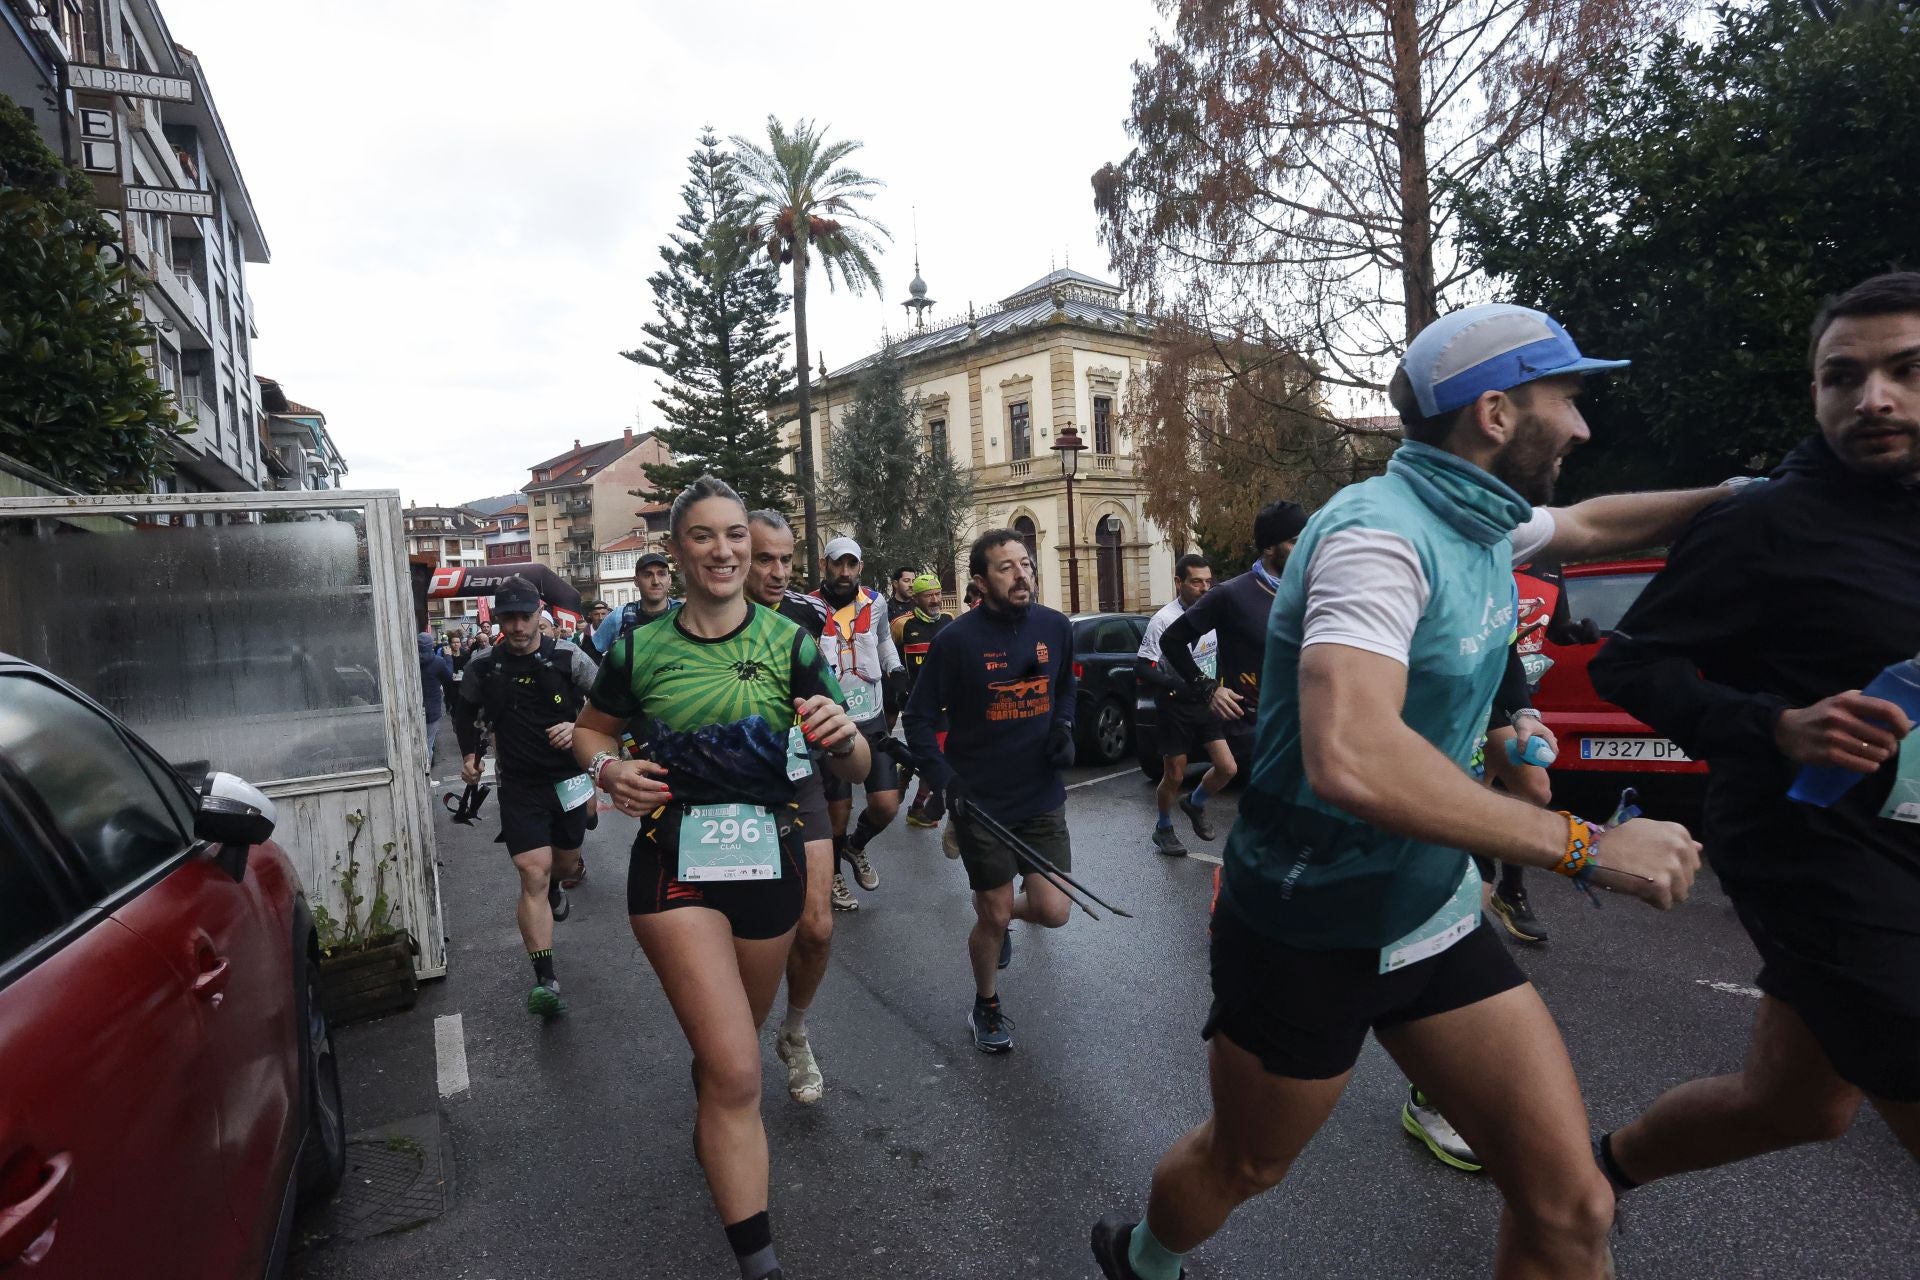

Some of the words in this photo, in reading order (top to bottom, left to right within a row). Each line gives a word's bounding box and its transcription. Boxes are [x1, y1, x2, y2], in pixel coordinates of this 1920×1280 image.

[74, 68, 190, 99] ALBERGUE
[127, 189, 212, 213] HOSTEL
[846, 694, 864, 707] 60
[1594, 741, 1646, 757] 7327
[1653, 741, 1688, 758] DP
[701, 818, 760, 844] 296
